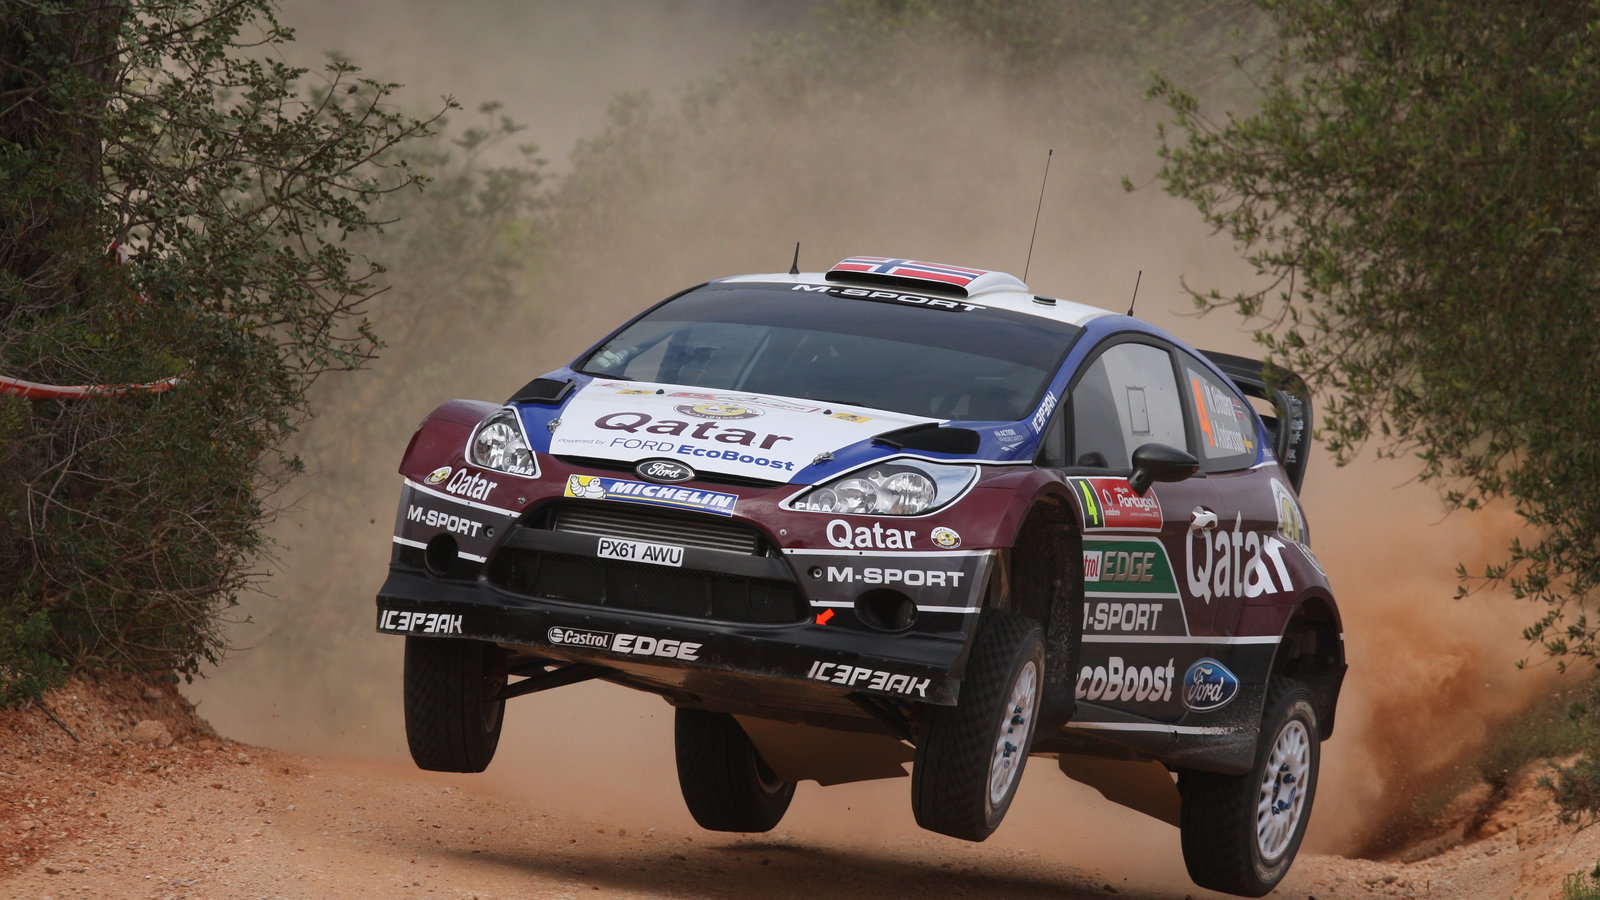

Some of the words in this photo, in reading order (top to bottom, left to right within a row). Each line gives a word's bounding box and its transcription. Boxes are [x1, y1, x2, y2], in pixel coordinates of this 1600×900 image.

[792, 284, 987, 312] M-SPORT
[1192, 379, 1215, 447] 4
[594, 411, 794, 450] Qatar
[507, 465, 534, 475] PIAA
[610, 437, 674, 452] FORD
[676, 444, 795, 472] EcoBoost
[647, 462, 682, 478] Ford
[446, 468, 498, 501] Qatar
[609, 481, 734, 508] MICHELIN
[795, 501, 831, 511] PIAA
[1079, 480, 1098, 525] 4
[1117, 494, 1157, 511] Portugal
[407, 504, 482, 538] M-SPORT
[826, 519, 917, 550] Qatar
[599, 540, 637, 559] PX61
[642, 545, 682, 564] AWU
[1101, 551, 1156, 582] EDGE
[1186, 510, 1294, 605] Qatar
[827, 566, 965, 588] M-SPORT
[563, 629, 609, 647] Castrol
[611, 633, 702, 661] EDGE
[1075, 656, 1175, 702] coBoost
[1187, 667, 1224, 702] Ford
